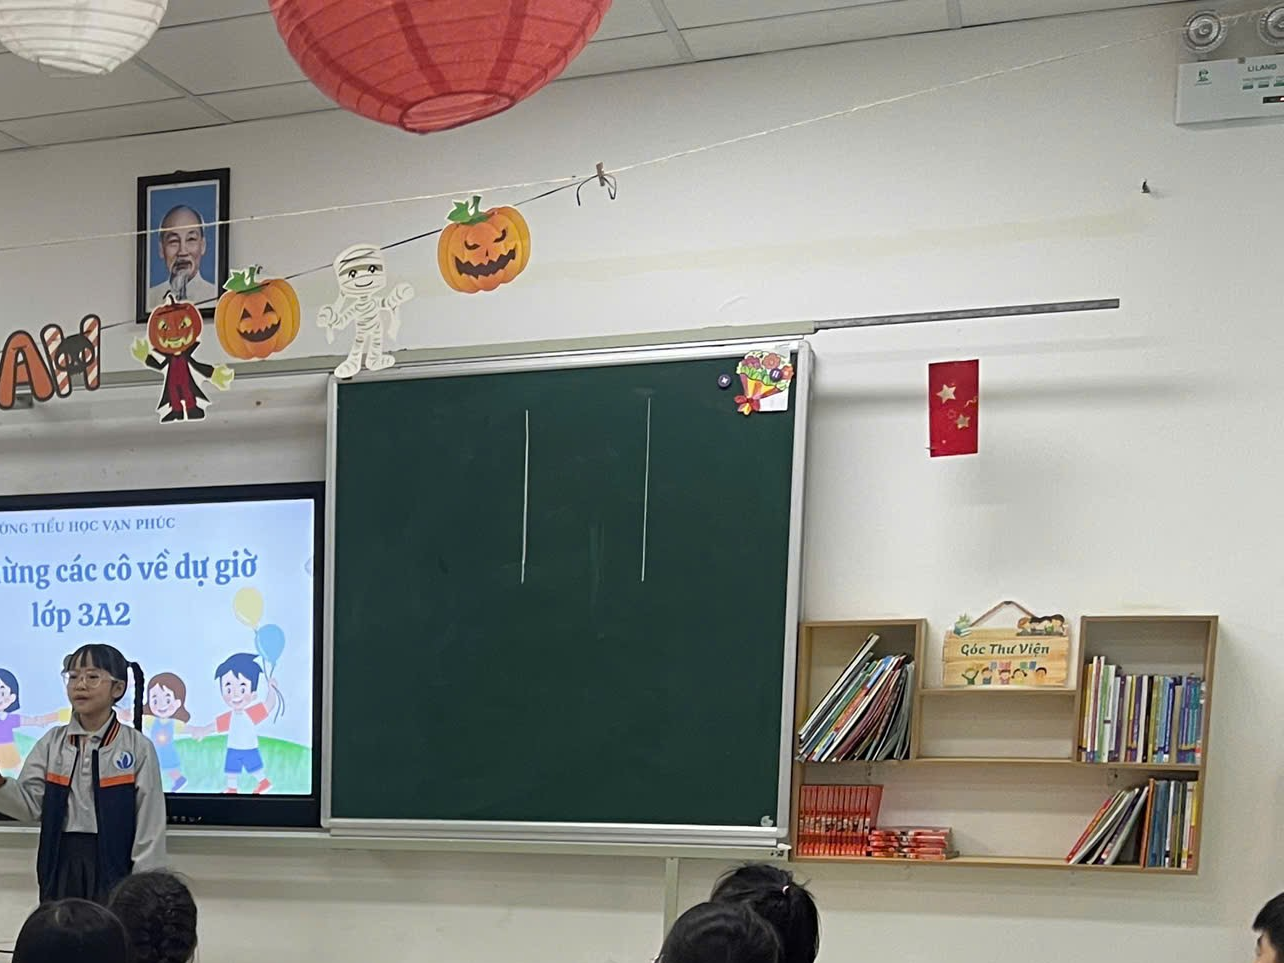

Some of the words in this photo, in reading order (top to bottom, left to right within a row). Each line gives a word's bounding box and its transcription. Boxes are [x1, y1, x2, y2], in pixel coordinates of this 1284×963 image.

[31, 516, 65, 535] TIỂU
[68, 519, 99, 535] HỌC
[102, 518, 131, 534] VẠN
[135, 515, 176, 530] PHÚC
[55, 553, 98, 583] các
[103, 552, 133, 582] cô
[137, 548, 171, 581] về
[174, 551, 210, 588] dự
[214, 547, 258, 586] giờ
[31, 599, 72, 633] lớp
[77, 601, 132, 628] 3A2
[960, 643, 987, 657] Góc
[988, 642, 1018, 656] Thư
[1019, 641, 1050, 658] Viện
